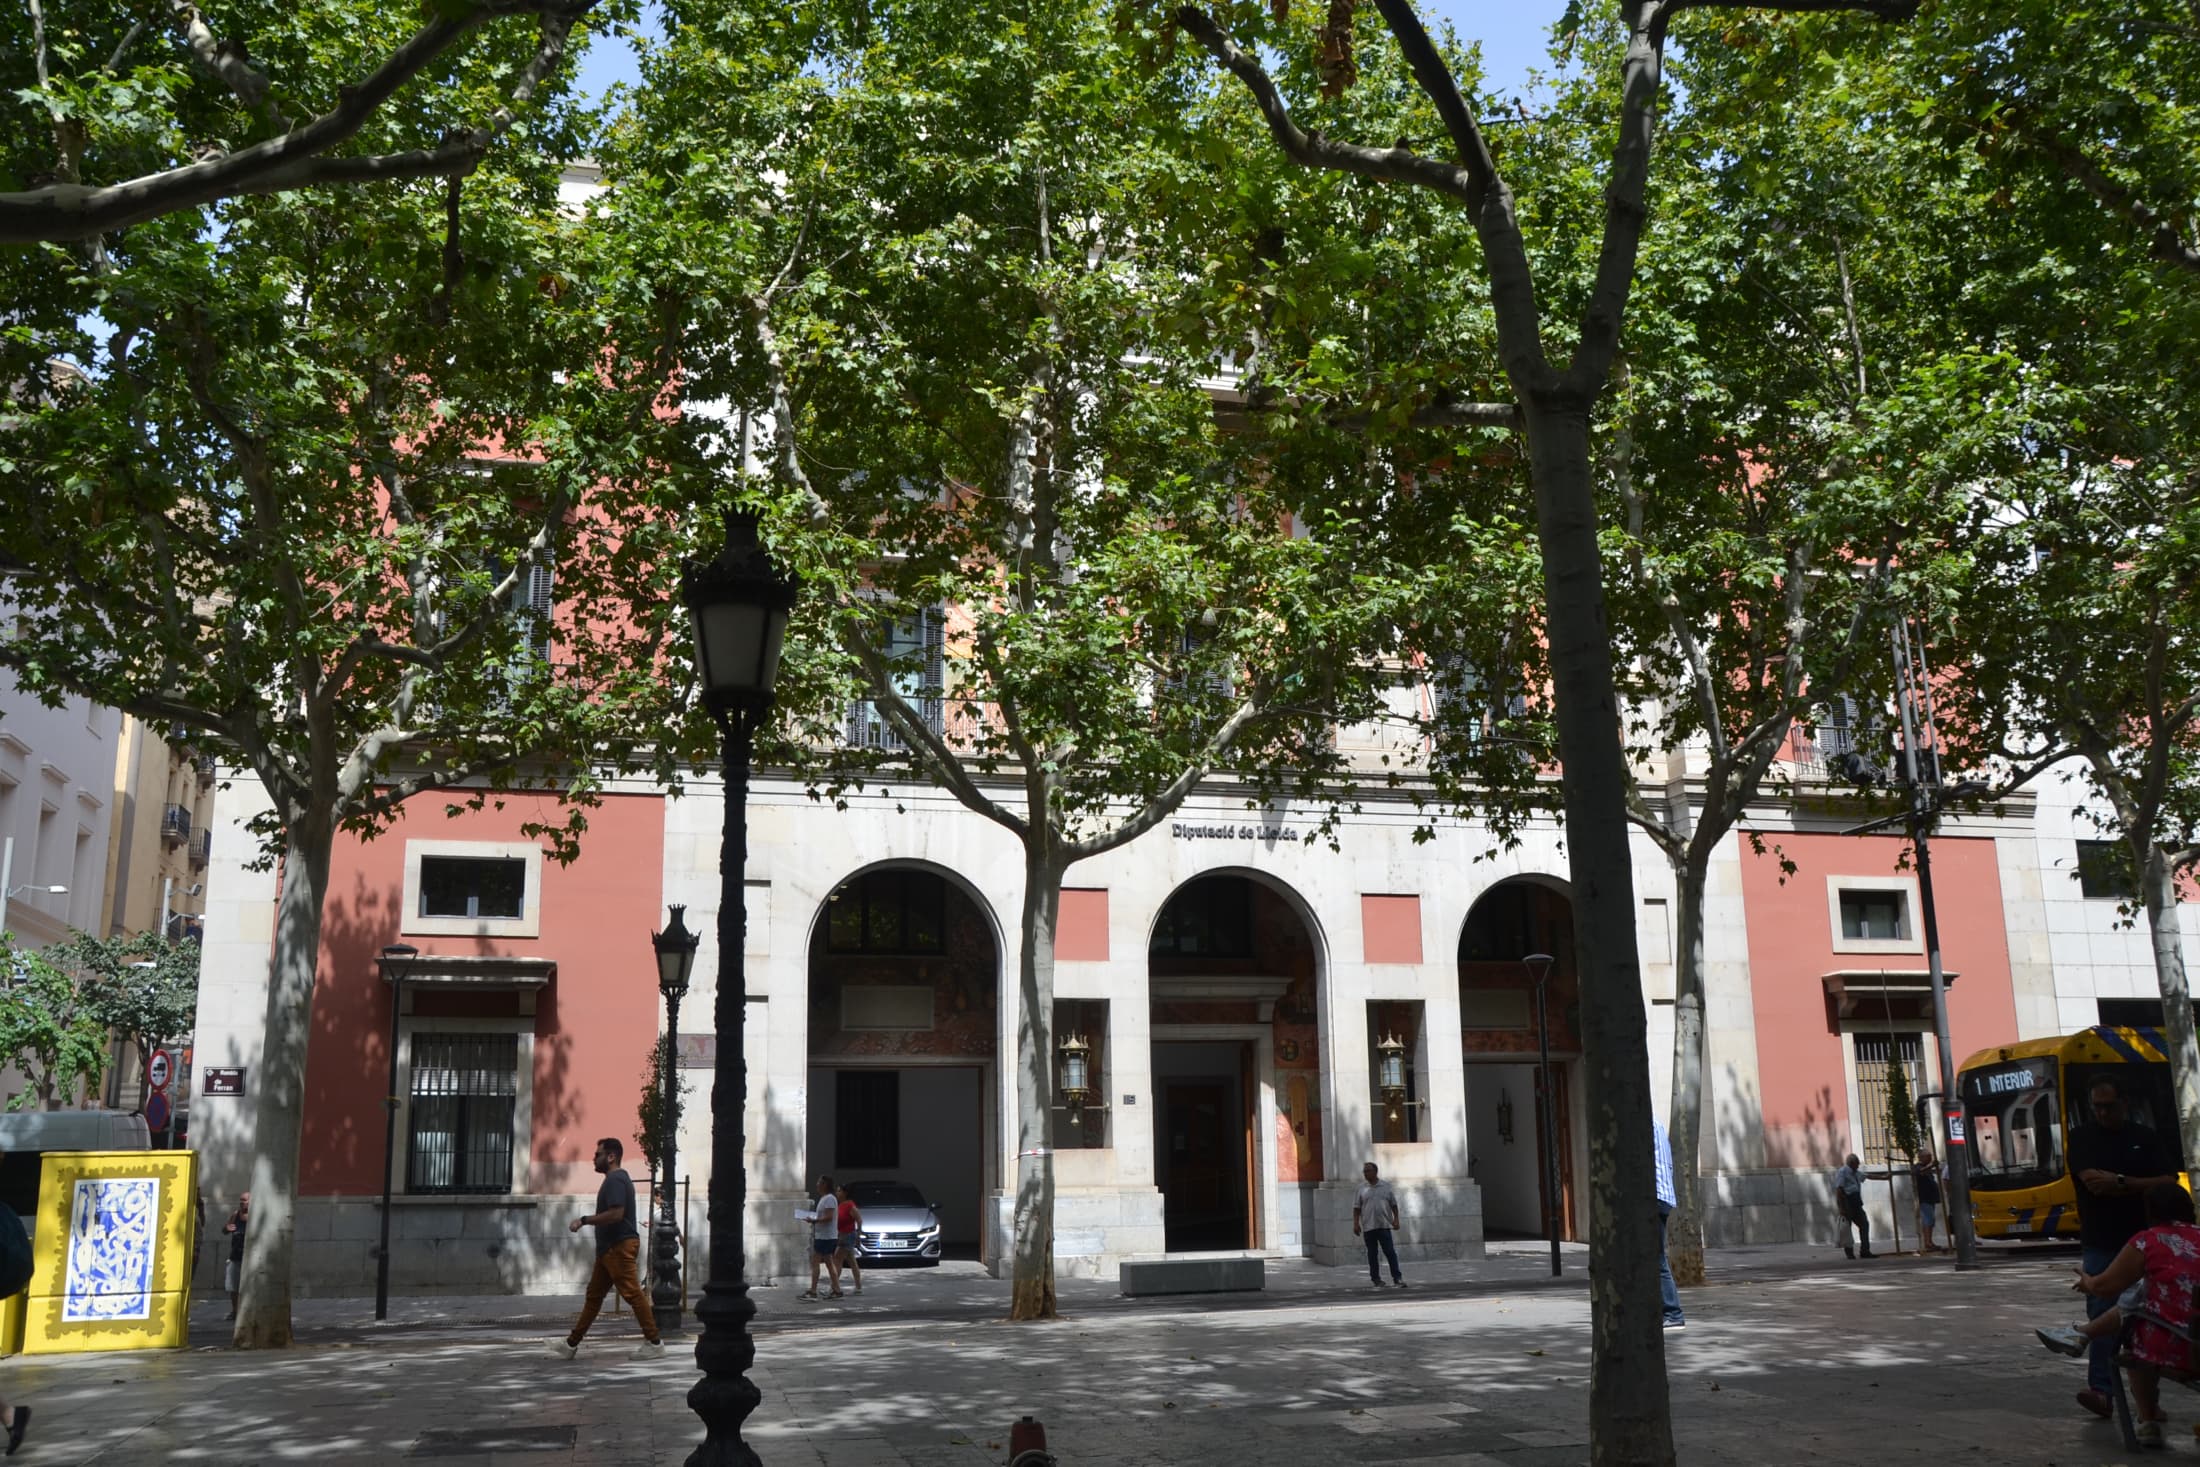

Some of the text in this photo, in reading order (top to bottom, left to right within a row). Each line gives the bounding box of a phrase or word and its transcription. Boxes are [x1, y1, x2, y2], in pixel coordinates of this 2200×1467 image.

[1172, 823, 1298, 841] Diputació de Lleida
[1975, 1070, 2034, 1096] 1 INTERIOR
